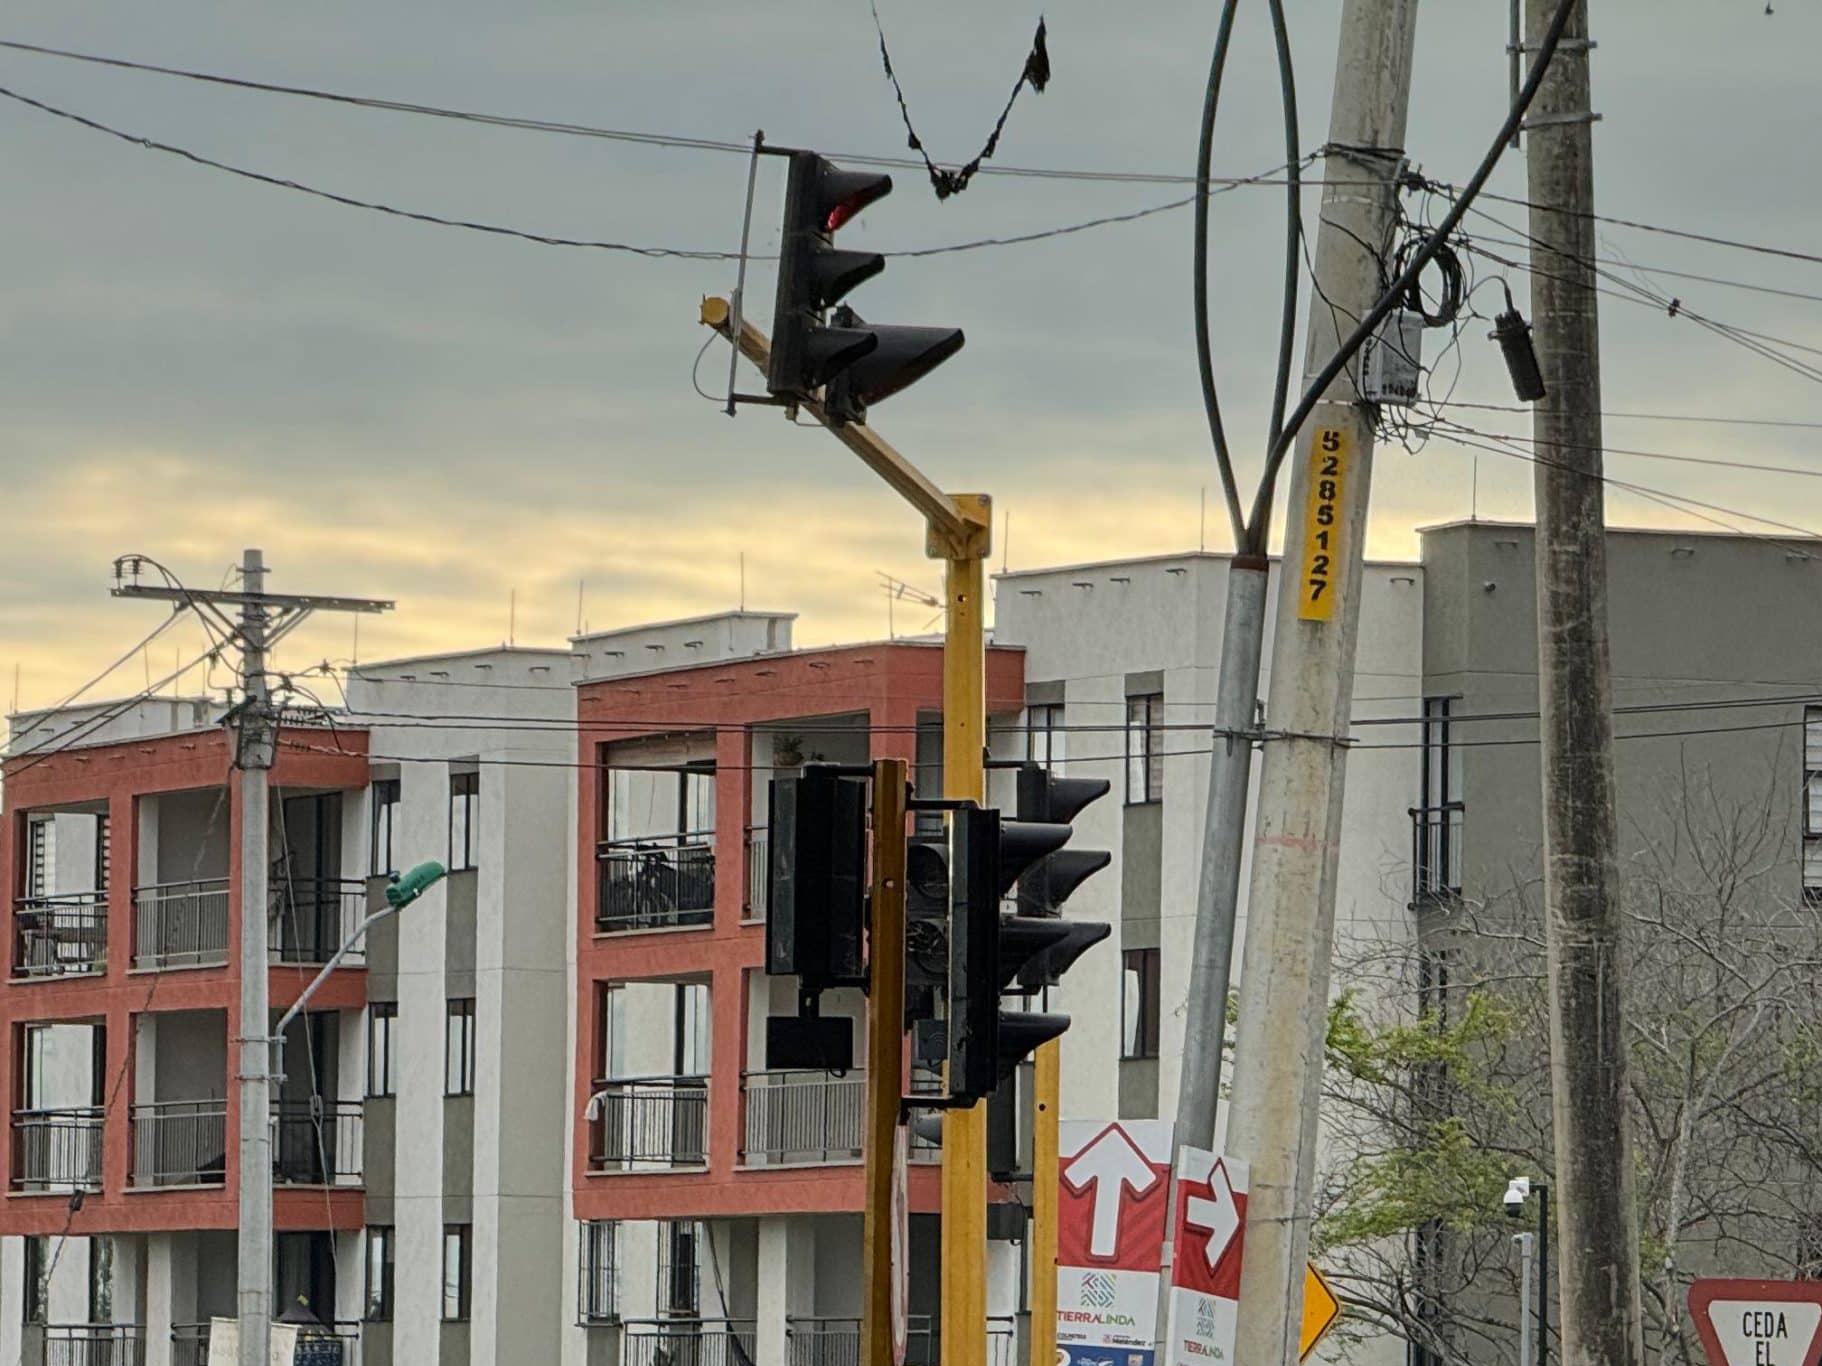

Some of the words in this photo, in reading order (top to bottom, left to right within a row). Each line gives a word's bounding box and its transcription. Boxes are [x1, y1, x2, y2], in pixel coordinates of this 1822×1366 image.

[1308, 430, 1340, 601] 5285127
[1057, 1311, 1136, 1326] TIERRALINDA
[1743, 1311, 1788, 1338] CEDA
